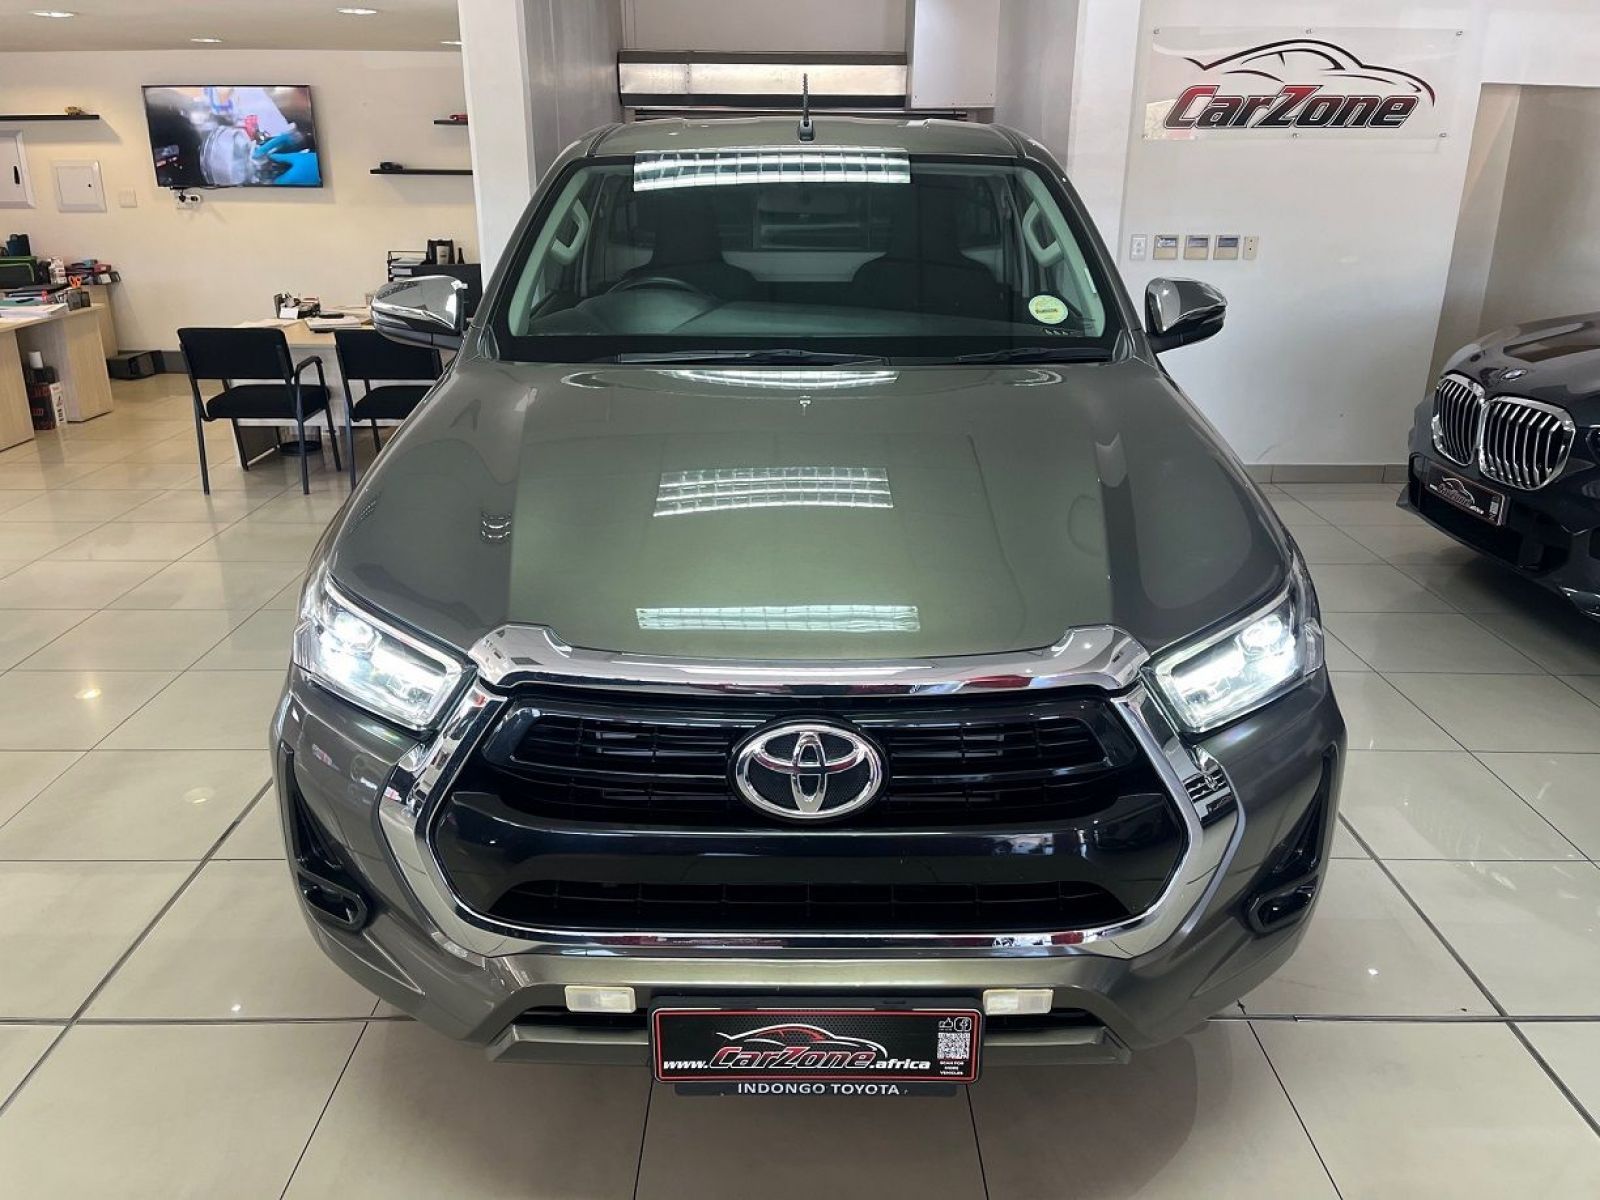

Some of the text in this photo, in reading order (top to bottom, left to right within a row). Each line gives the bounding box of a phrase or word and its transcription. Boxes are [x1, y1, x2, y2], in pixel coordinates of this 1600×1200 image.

[1164, 84, 1419, 128] CarZone
[737, 1083, 900, 1095] INDONGO TOYOTA
